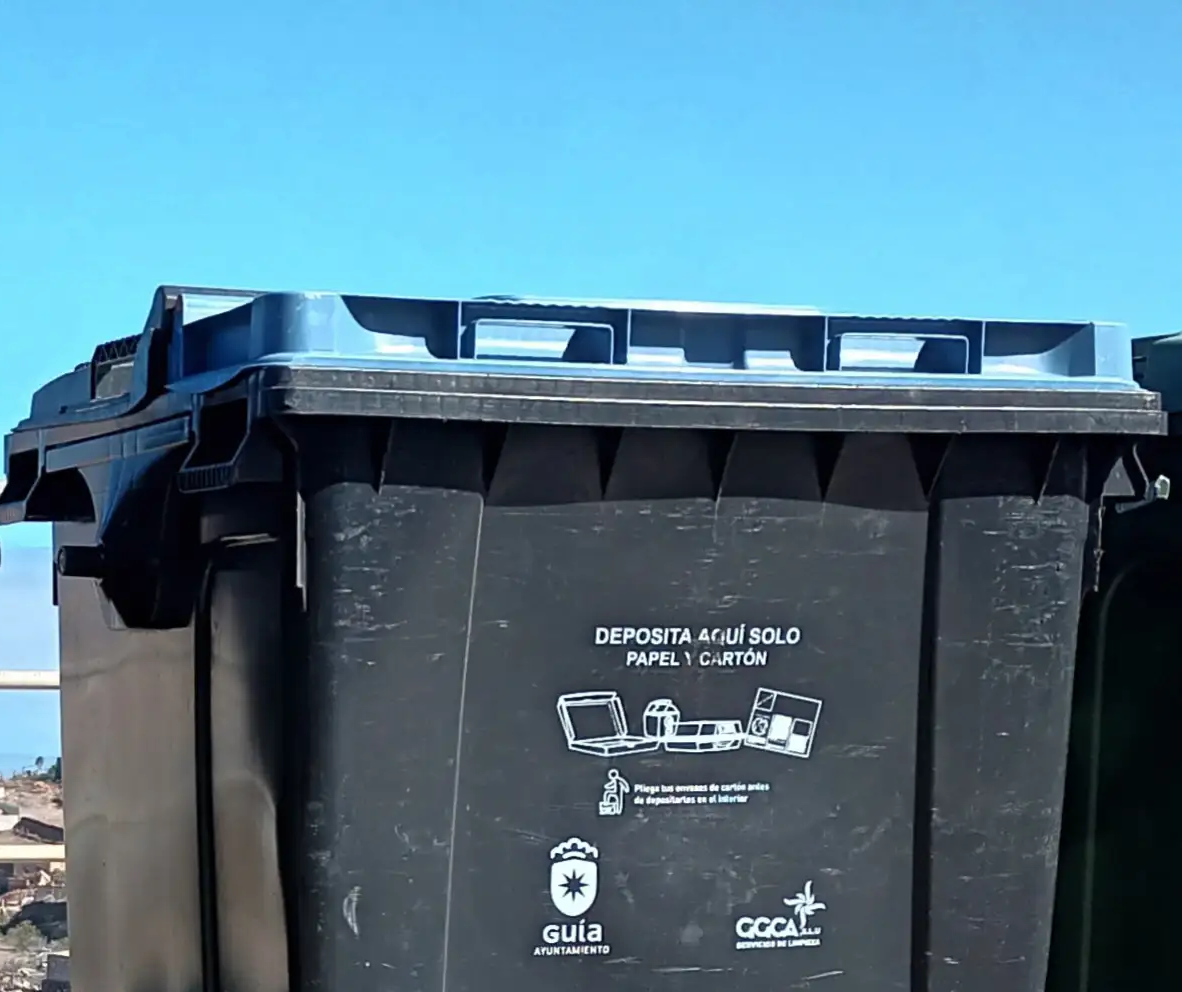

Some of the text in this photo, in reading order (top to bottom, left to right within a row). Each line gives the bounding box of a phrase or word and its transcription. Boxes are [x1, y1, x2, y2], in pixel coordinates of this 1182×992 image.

[595, 623, 800, 645] DEPOSITA AQUÍ SOLO
[626, 651, 679, 666] PAPEL
[699, 648, 767, 666] CARTÓN
[533, 945, 610, 956] AYUNTAMIENTO
